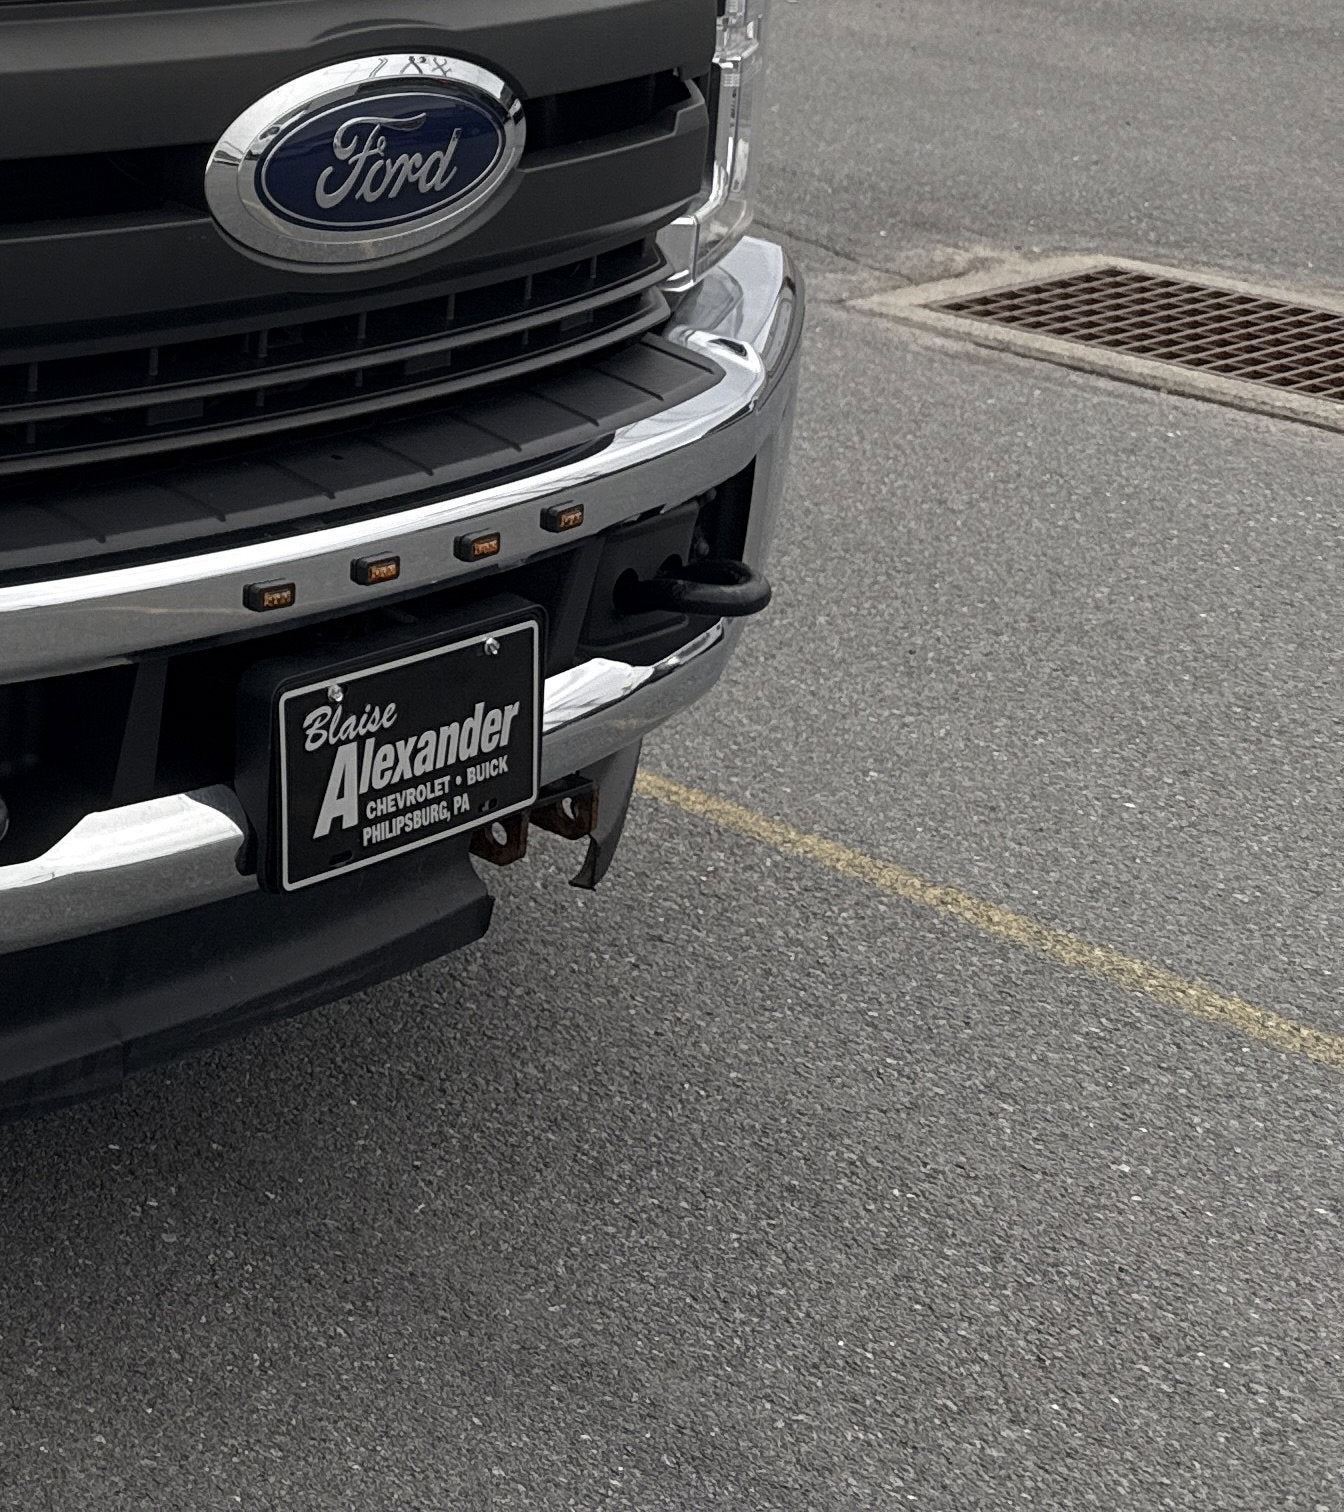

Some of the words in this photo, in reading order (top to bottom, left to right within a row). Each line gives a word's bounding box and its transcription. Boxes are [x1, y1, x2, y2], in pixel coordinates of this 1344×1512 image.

[315, 112, 462, 209] Ford
[302, 702, 398, 751] Blaise
[313, 701, 520, 839] Alexander
[366, 775, 451, 819] CHEVROLET
[466, 755, 509, 786] BUICK
[363, 804, 451, 847] PHILIPSBURG,
[453, 793, 470, 815] PA
